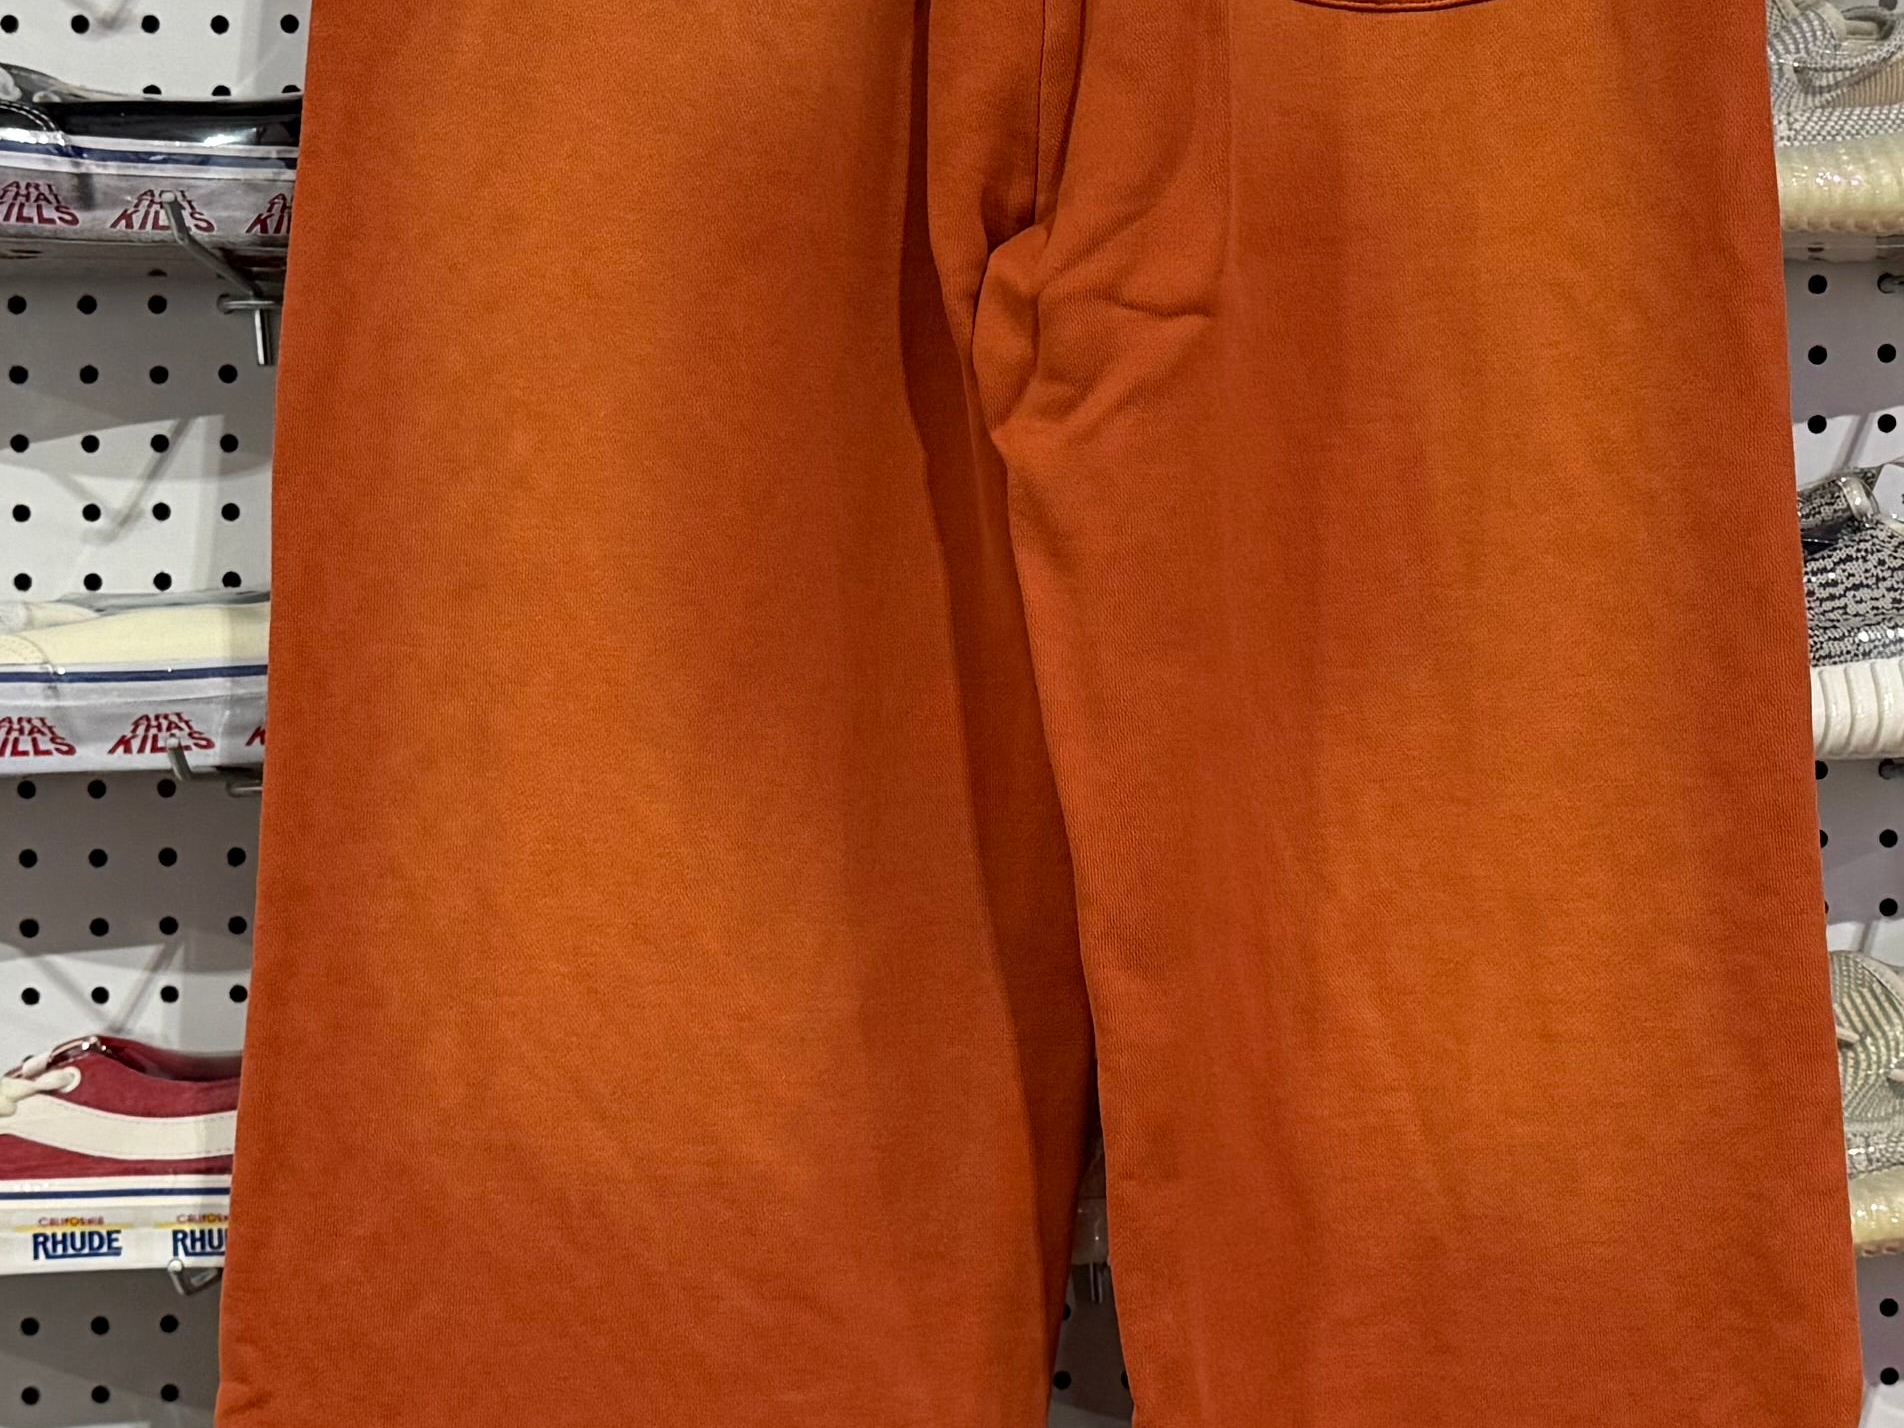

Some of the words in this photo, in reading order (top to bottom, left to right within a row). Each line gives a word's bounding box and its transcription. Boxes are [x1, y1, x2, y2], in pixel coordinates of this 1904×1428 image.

[109, 207, 216, 233] KILS
[32, 1229, 123, 1261] RHUDE
[171, 1228, 229, 1257] RHU
